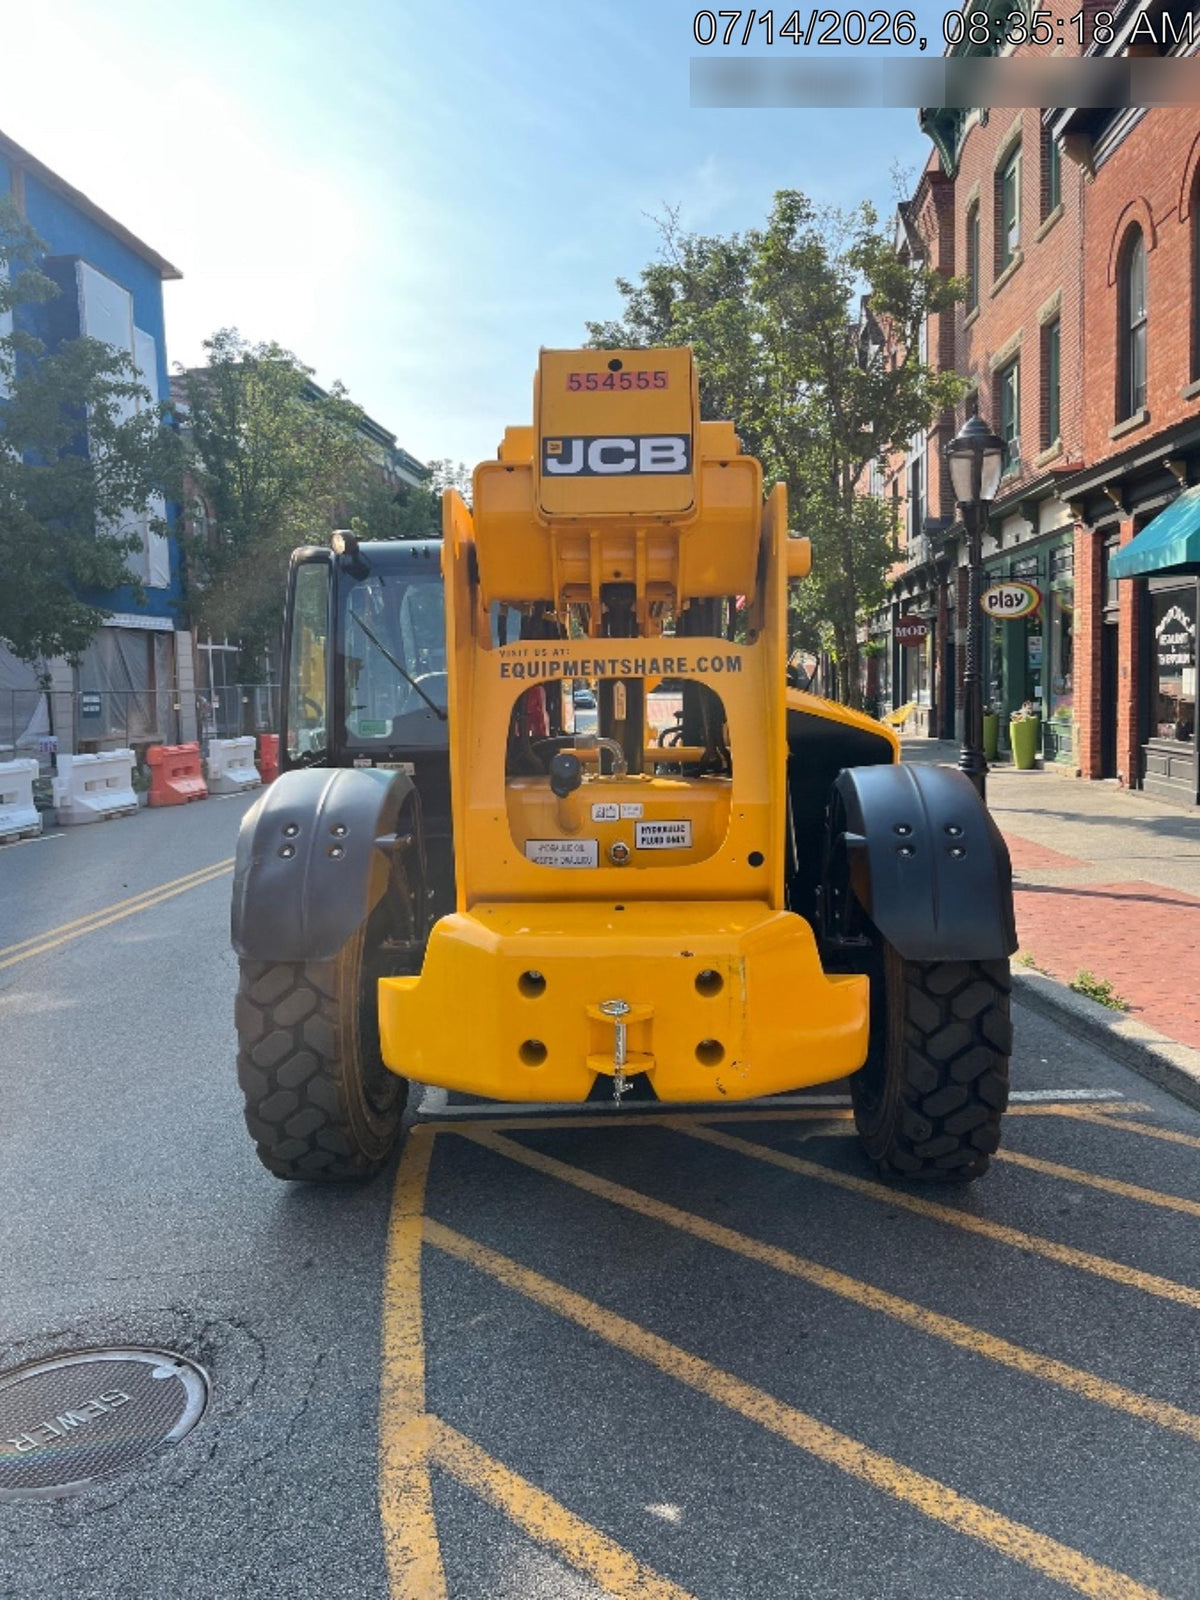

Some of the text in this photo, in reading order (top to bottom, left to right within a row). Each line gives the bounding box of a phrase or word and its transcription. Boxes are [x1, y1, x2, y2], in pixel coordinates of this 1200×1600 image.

[568, 371, 667, 392] 554555
[546, 437, 687, 474] JCB
[988, 591, 1025, 609] play
[895, 624, 928, 637] MOD
[499, 649, 529, 658] VISIT
[534, 648, 547, 657] US
[500, 656, 743, 679] EQUIPMENTSHARE.COM
[7, 1389, 133, 1453] SEWER
